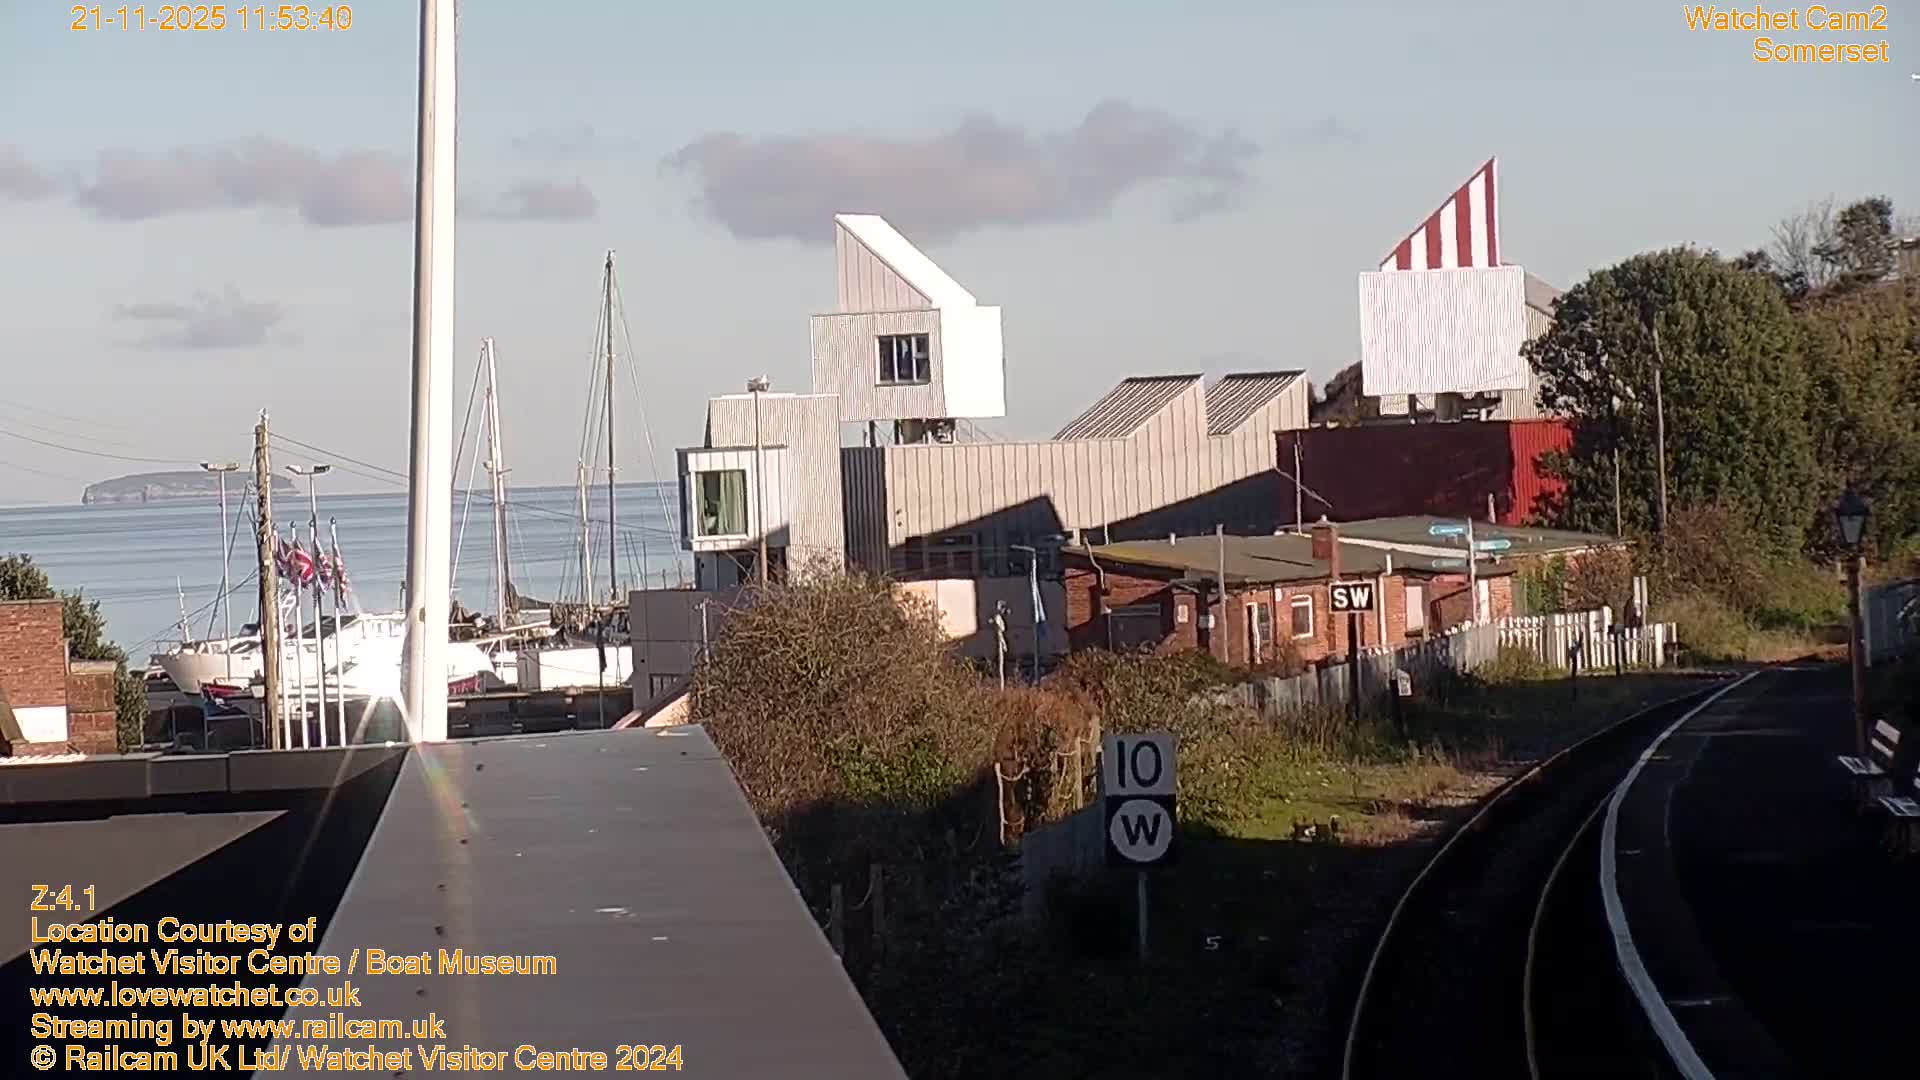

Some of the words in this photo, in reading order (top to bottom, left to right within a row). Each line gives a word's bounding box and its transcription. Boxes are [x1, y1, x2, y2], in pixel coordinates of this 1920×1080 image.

[1333, 586, 1369, 609] SW
[1117, 740, 1162, 788] 10
[1121, 814, 1162, 846] W
